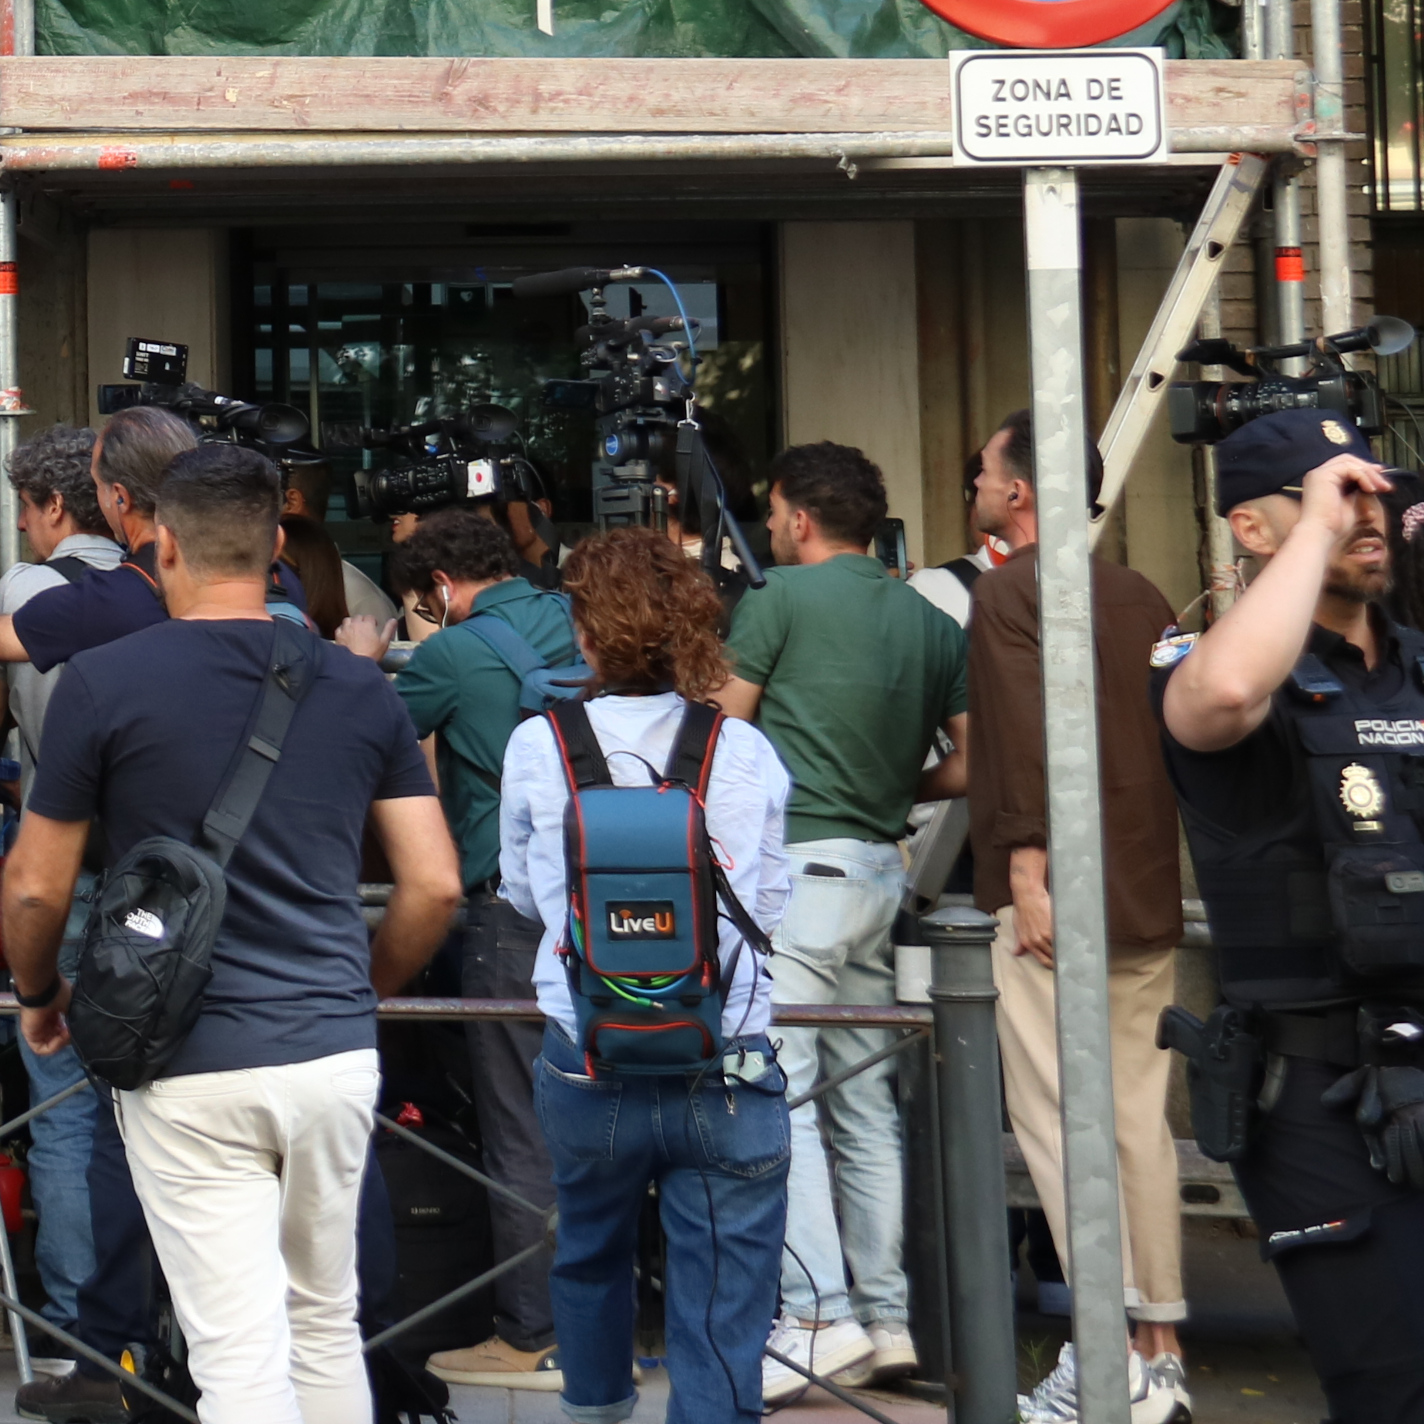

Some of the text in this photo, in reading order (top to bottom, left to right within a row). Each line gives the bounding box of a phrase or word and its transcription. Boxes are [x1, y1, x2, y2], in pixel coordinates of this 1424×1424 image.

[991, 77, 1124, 102] ZONA DE
[974, 113, 1144, 138] SEGURIDAD
[1354, 719, 1424, 733] POLICIA
[610, 909, 671, 933] LiveU
